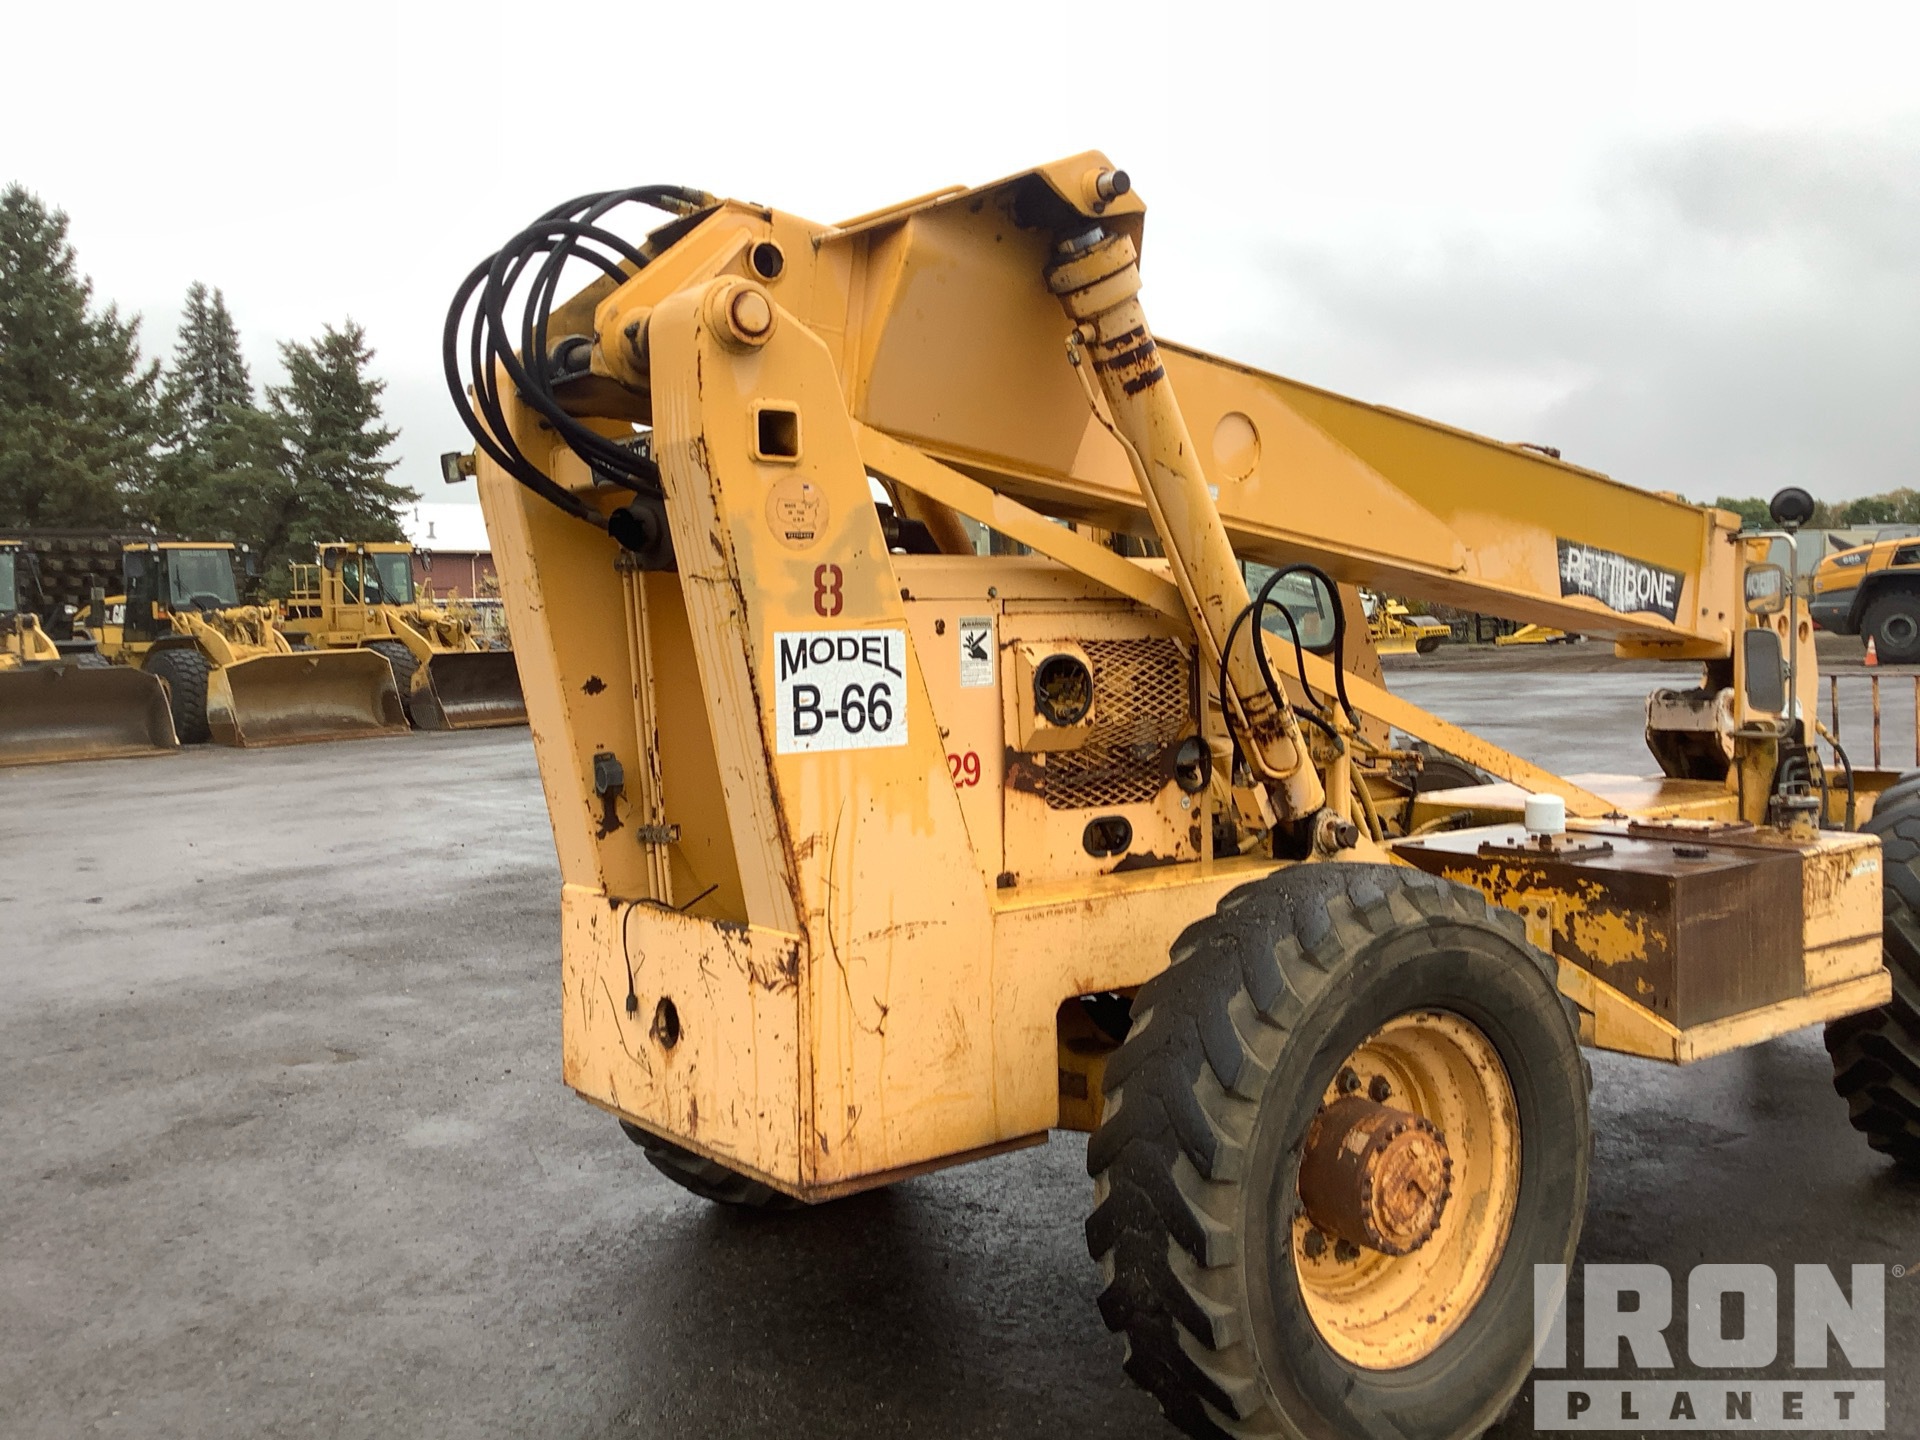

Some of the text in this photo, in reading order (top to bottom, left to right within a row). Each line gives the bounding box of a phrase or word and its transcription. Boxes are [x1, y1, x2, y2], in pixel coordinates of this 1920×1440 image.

[813, 563, 844, 618] 8
[1566, 545, 1676, 610] PETTIBONE
[780, 635, 903, 682] MODEL
[792, 682, 893, 737] B-66
